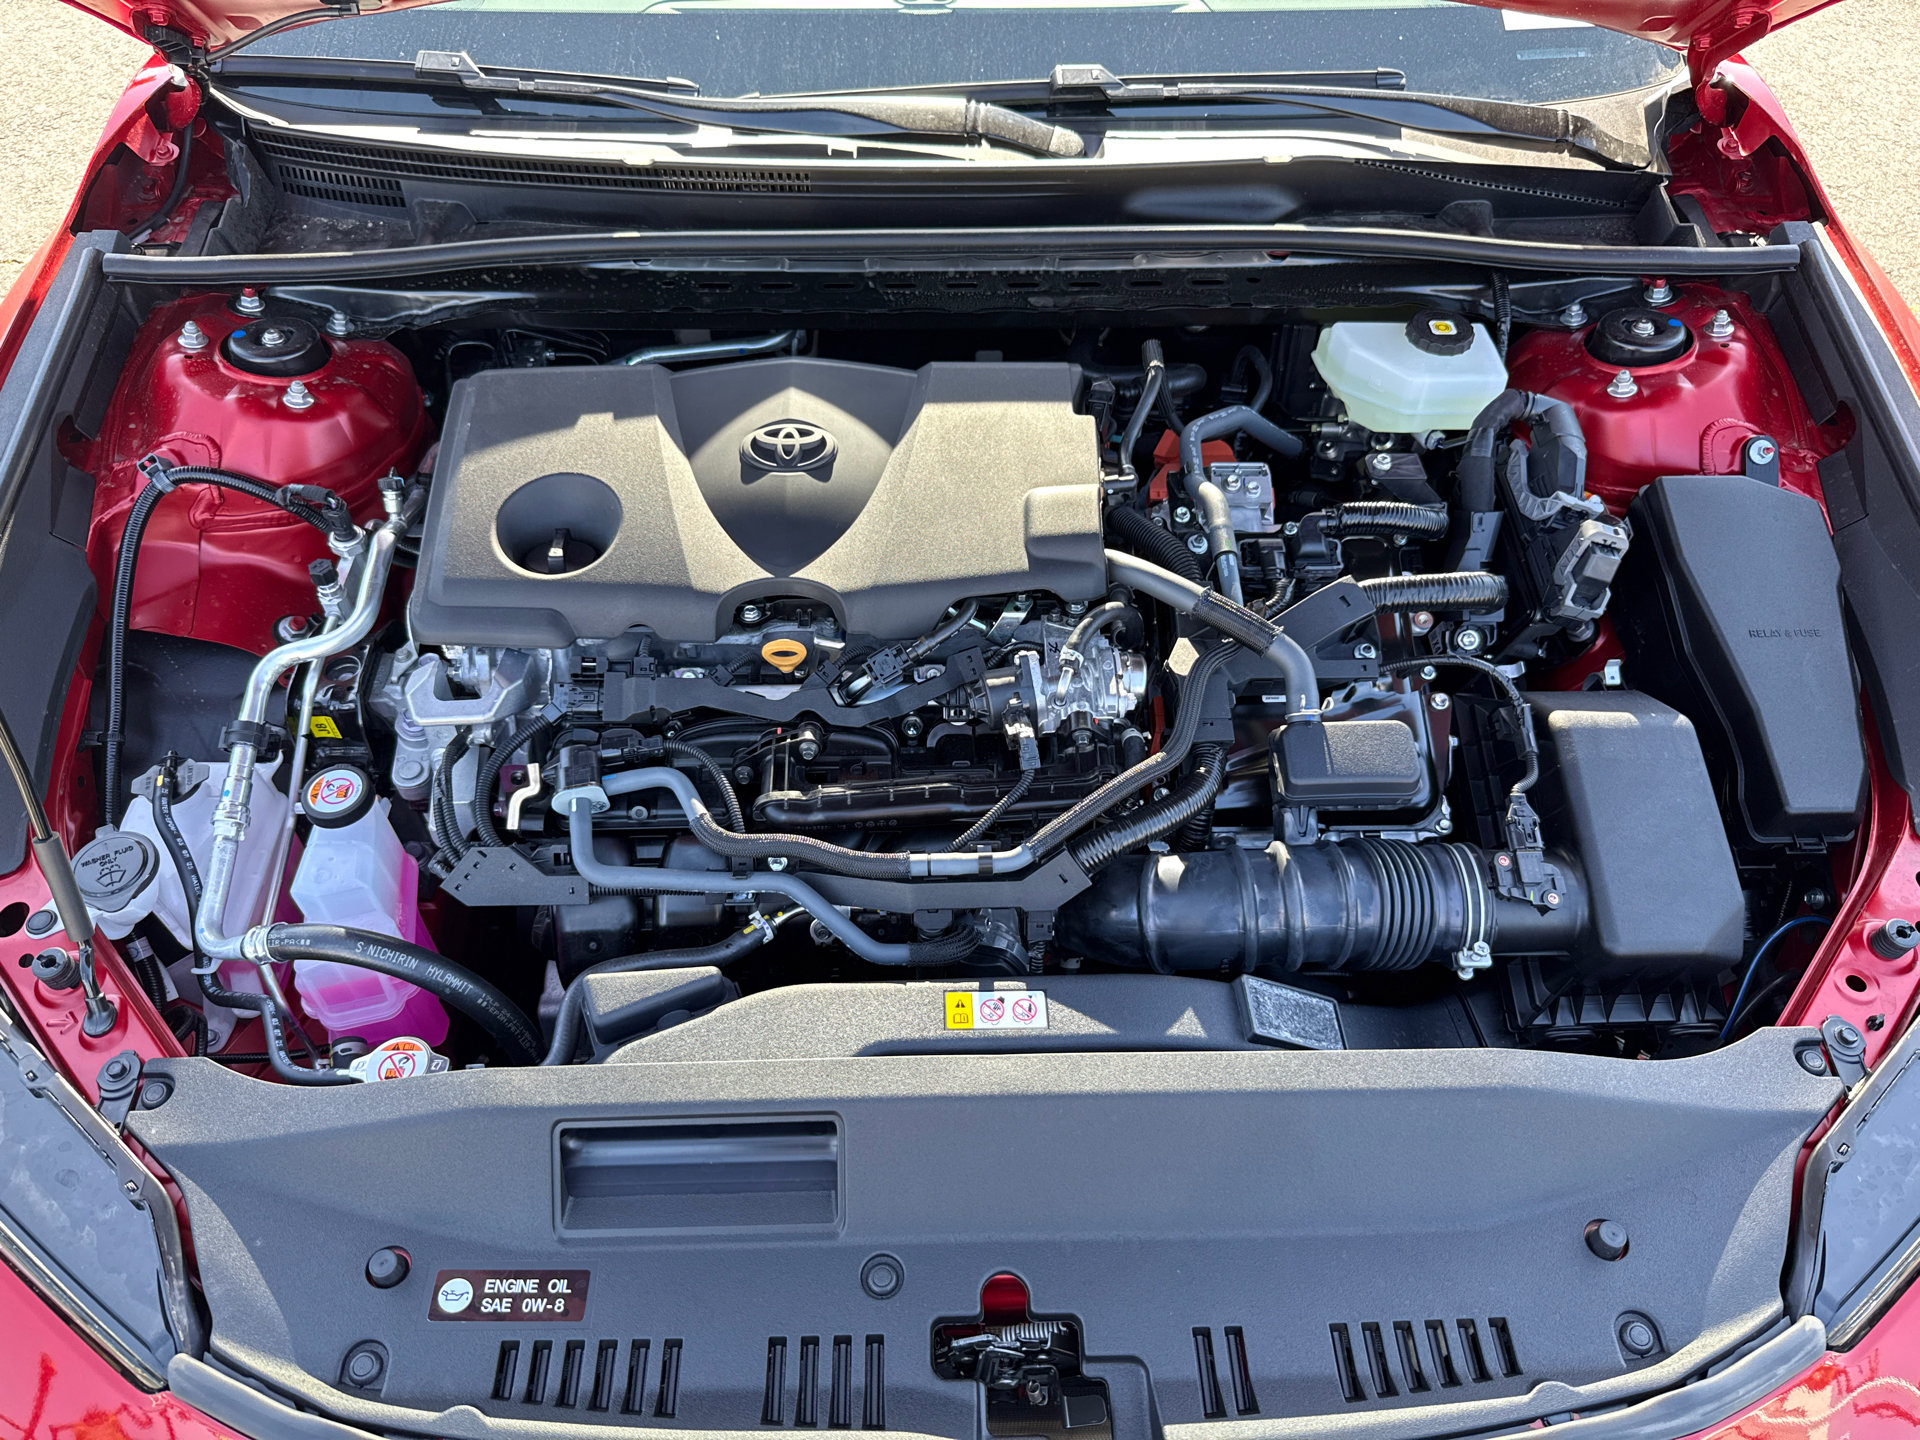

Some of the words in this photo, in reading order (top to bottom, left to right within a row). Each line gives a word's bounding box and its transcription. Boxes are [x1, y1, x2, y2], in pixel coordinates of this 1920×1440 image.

[1748, 629, 1781, 639] RELAY
[1784, 629, 1792, 638] &
[1793, 628, 1823, 638] FUSE
[315, 723, 331, 735] J8
[81, 853, 111, 868] WASHER
[114, 845, 134, 857] FLUID
[99, 857, 118, 868] ONLY
[425, 964, 474, 996] HYLAMMIT
[483, 1278, 540, 1294] ENGINE
[547, 1278, 572, 1294] OIL
[480, 1297, 513, 1313] SAE
[521, 1297, 565, 1313] 0W-8
